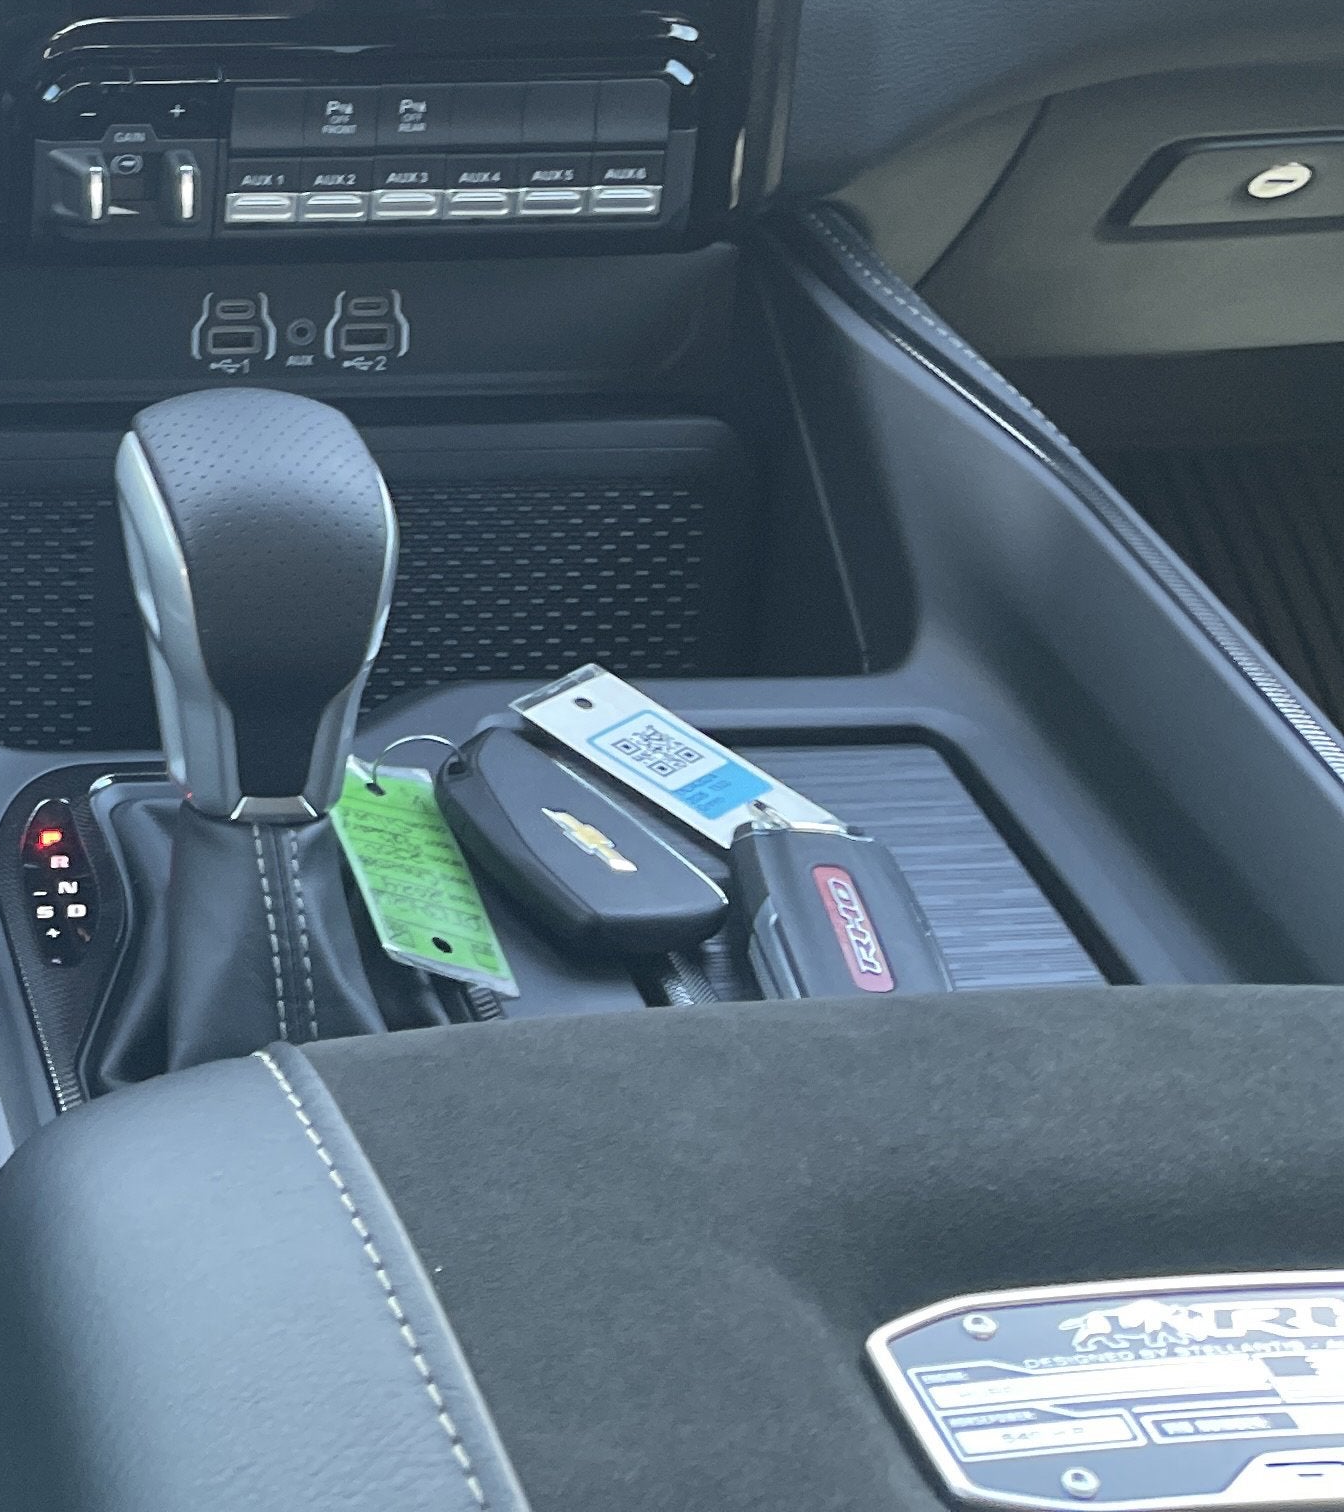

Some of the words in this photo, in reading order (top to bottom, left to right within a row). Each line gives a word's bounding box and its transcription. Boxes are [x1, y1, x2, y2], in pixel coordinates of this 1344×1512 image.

[113, 131, 147, 143] GAIN
[313, 174, 344, 186] AUX
[386, 172, 416, 184] AUX
[459, 171, 488, 183] AUX
[531, 169, 560, 182] AUX
[603, 167, 632, 180] AUX
[241, 175, 272, 186] AUX
[374, 356, 387, 371] 2
[58, 881, 78, 894] N
[36, 905, 55, 919] S
[828, 876, 883, 975] RHO
[1022, 1350, 1135, 1370] DESIGNED
